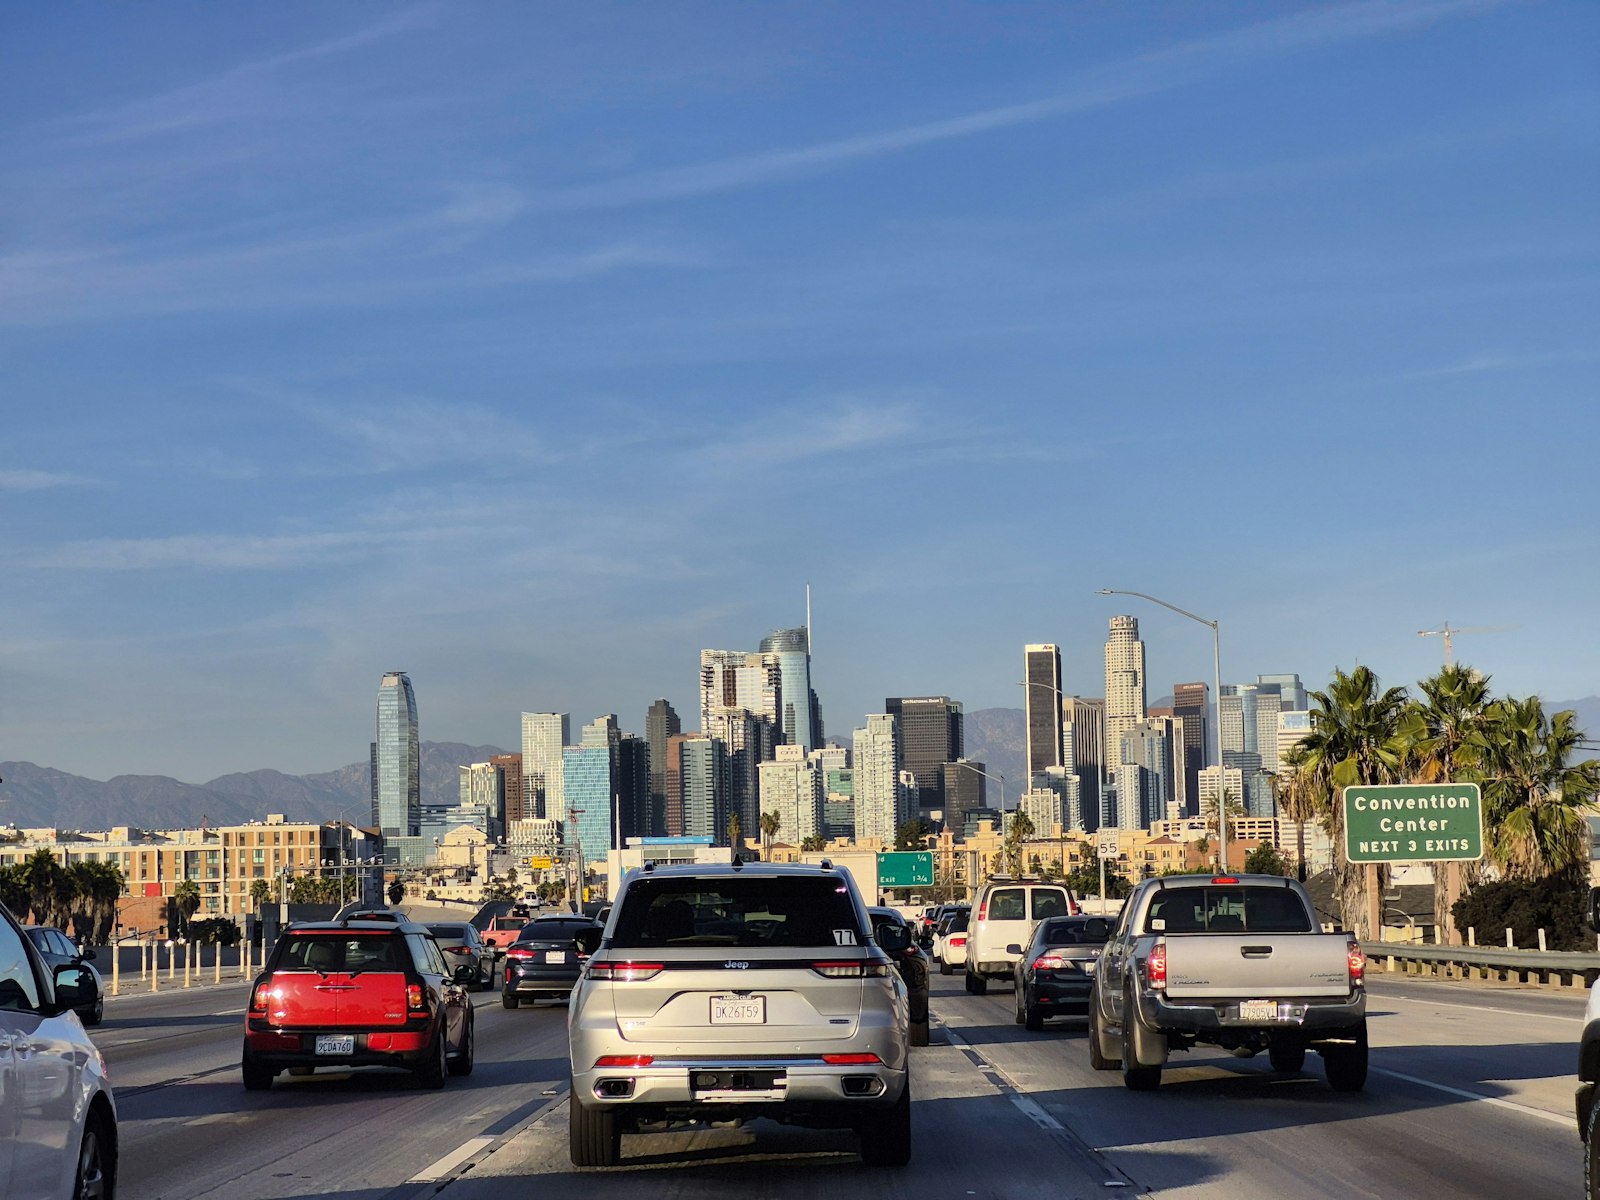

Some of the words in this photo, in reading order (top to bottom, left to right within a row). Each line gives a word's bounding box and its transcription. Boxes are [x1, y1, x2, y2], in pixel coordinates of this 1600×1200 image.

[1354, 794, 1470, 811] Convention
[1380, 817, 1449, 832] Center
[1100, 843, 1118, 853] 55
[1359, 841, 1399, 853] NEXT
[1408, 840, 1417, 852] 3
[1425, 839, 1469, 852] EXITS
[834, 930, 853, 945] 77
[724, 960, 749, 970] Jeep
[715, 1006, 759, 1018] DK26T59
[318, 1042, 351, 1052] 9CDA760
